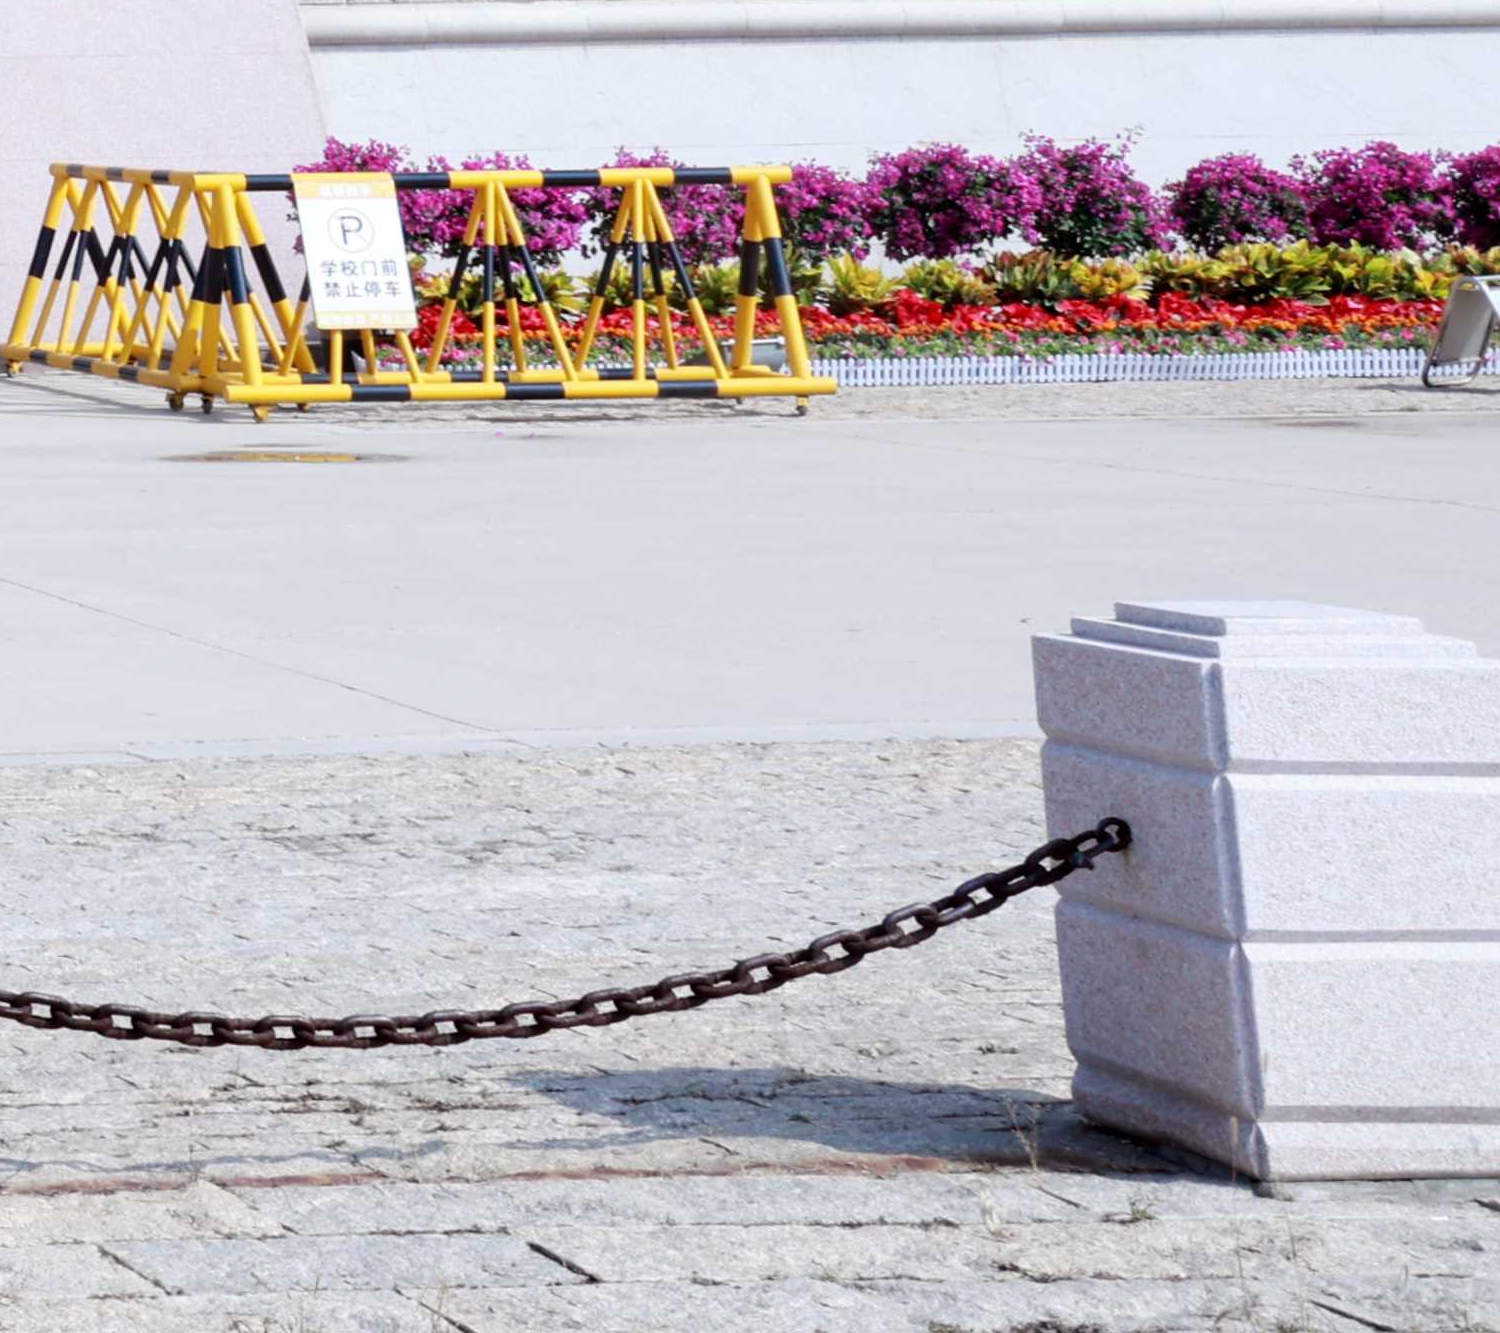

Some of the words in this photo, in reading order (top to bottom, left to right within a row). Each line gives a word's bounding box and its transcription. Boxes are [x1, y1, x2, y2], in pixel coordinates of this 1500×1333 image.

[339, 215, 363, 246] P
[320, 259, 398, 278] 学校门前
[324, 281, 402, 298] 禁止停车
